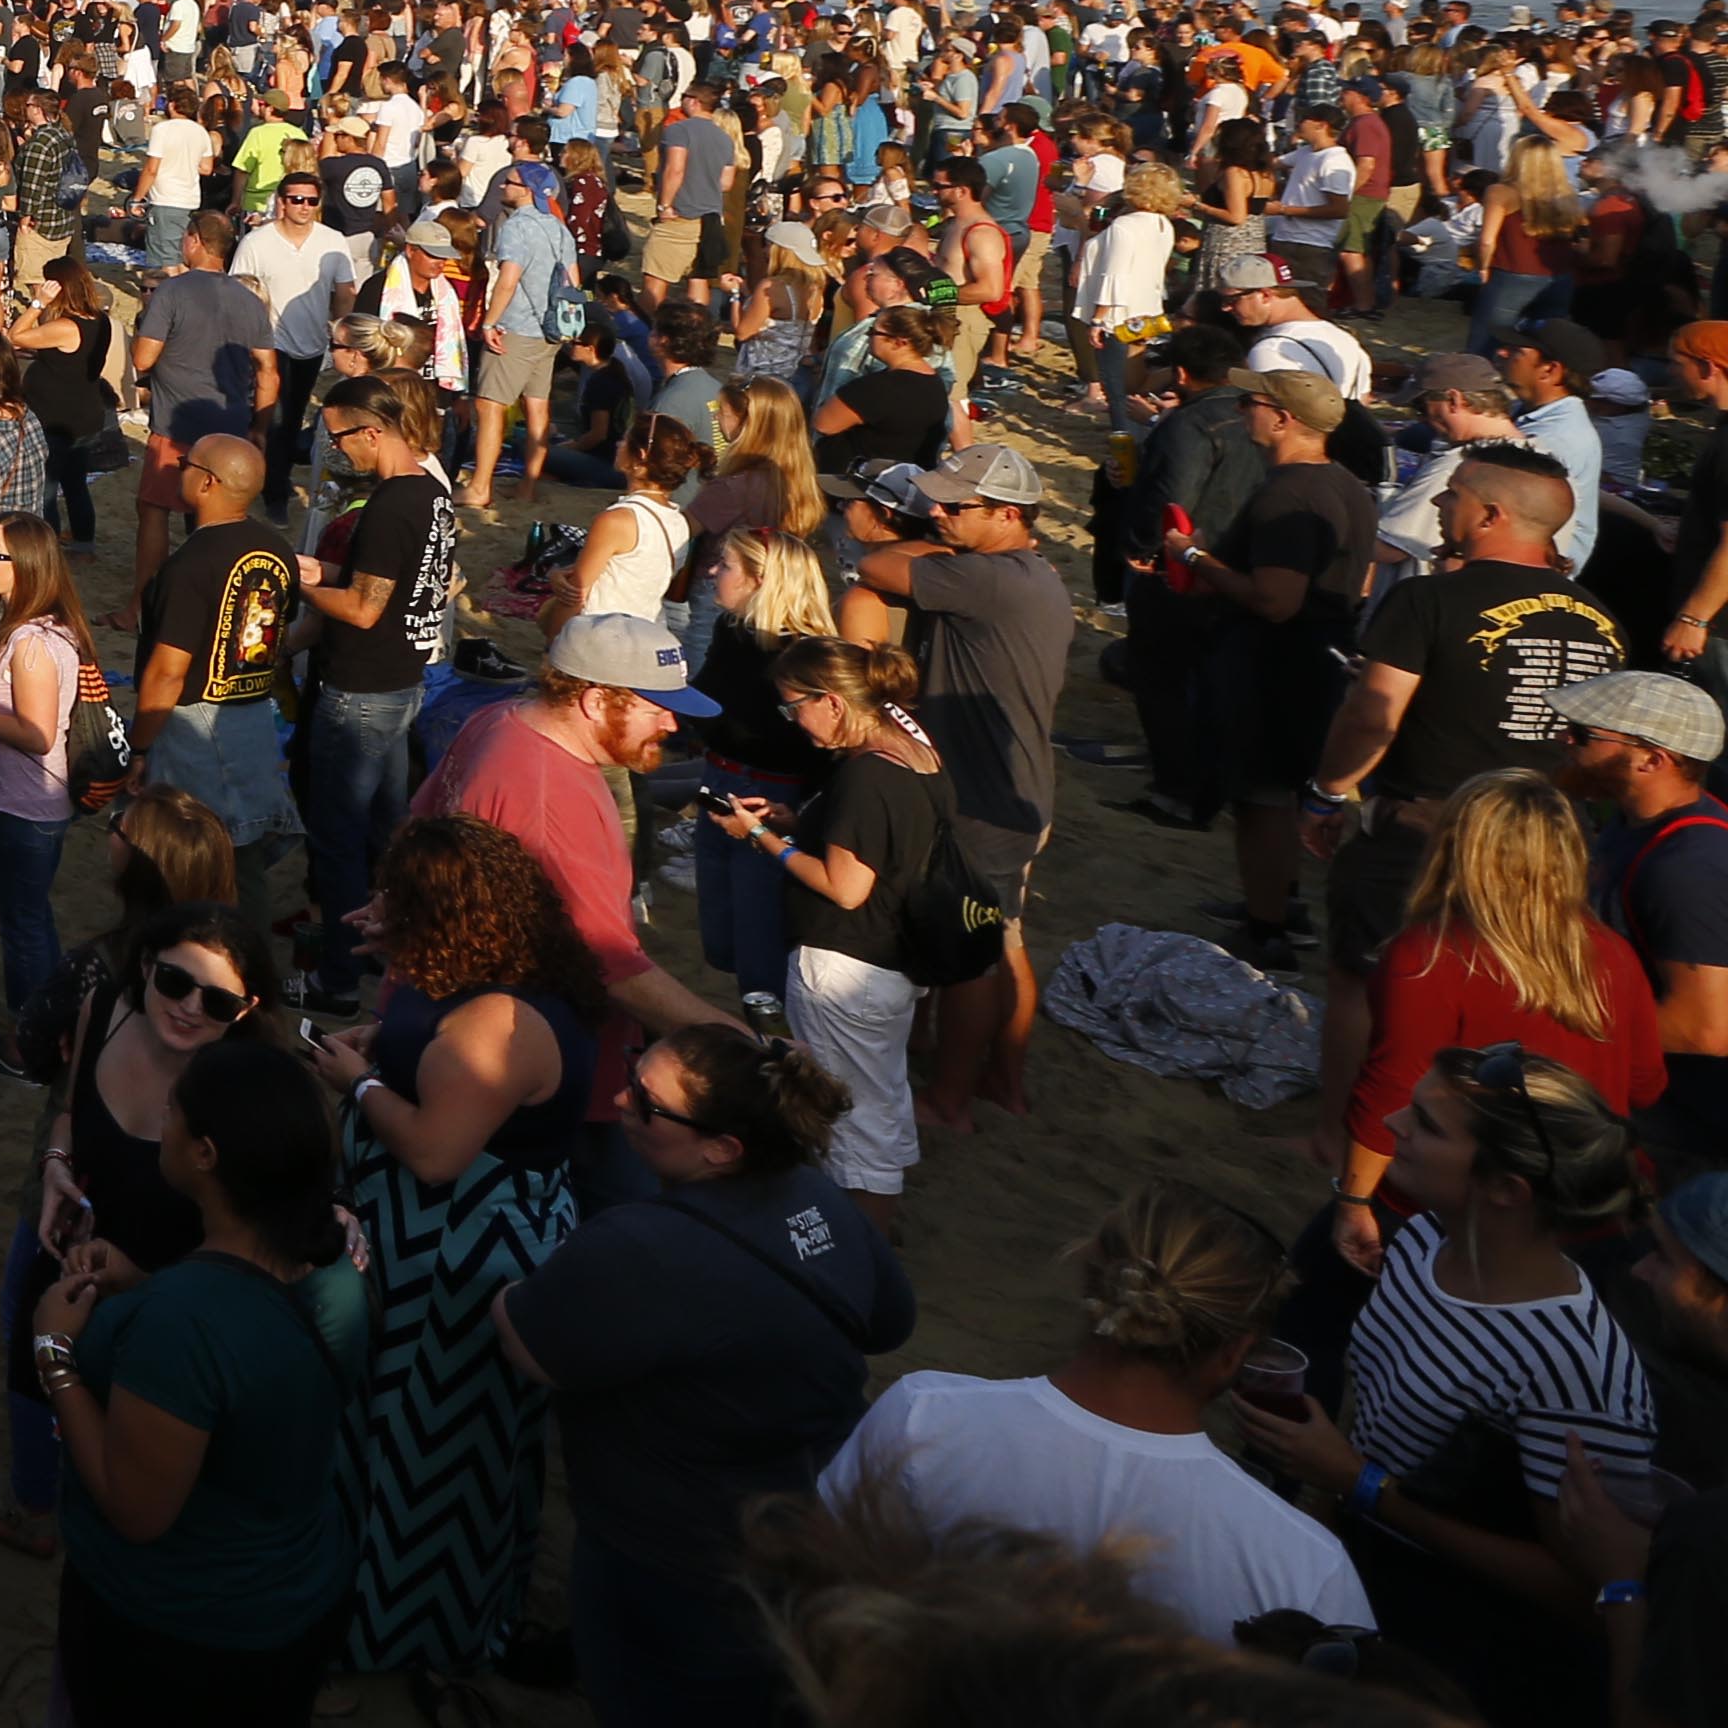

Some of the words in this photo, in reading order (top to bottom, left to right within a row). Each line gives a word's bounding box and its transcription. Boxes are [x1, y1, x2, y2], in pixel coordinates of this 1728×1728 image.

[221, 589, 239, 640] SOCIETY
[242, 557, 275, 575] MISERY
[656, 648, 679, 666] BIG
[808, 1222, 832, 1247] PONY
